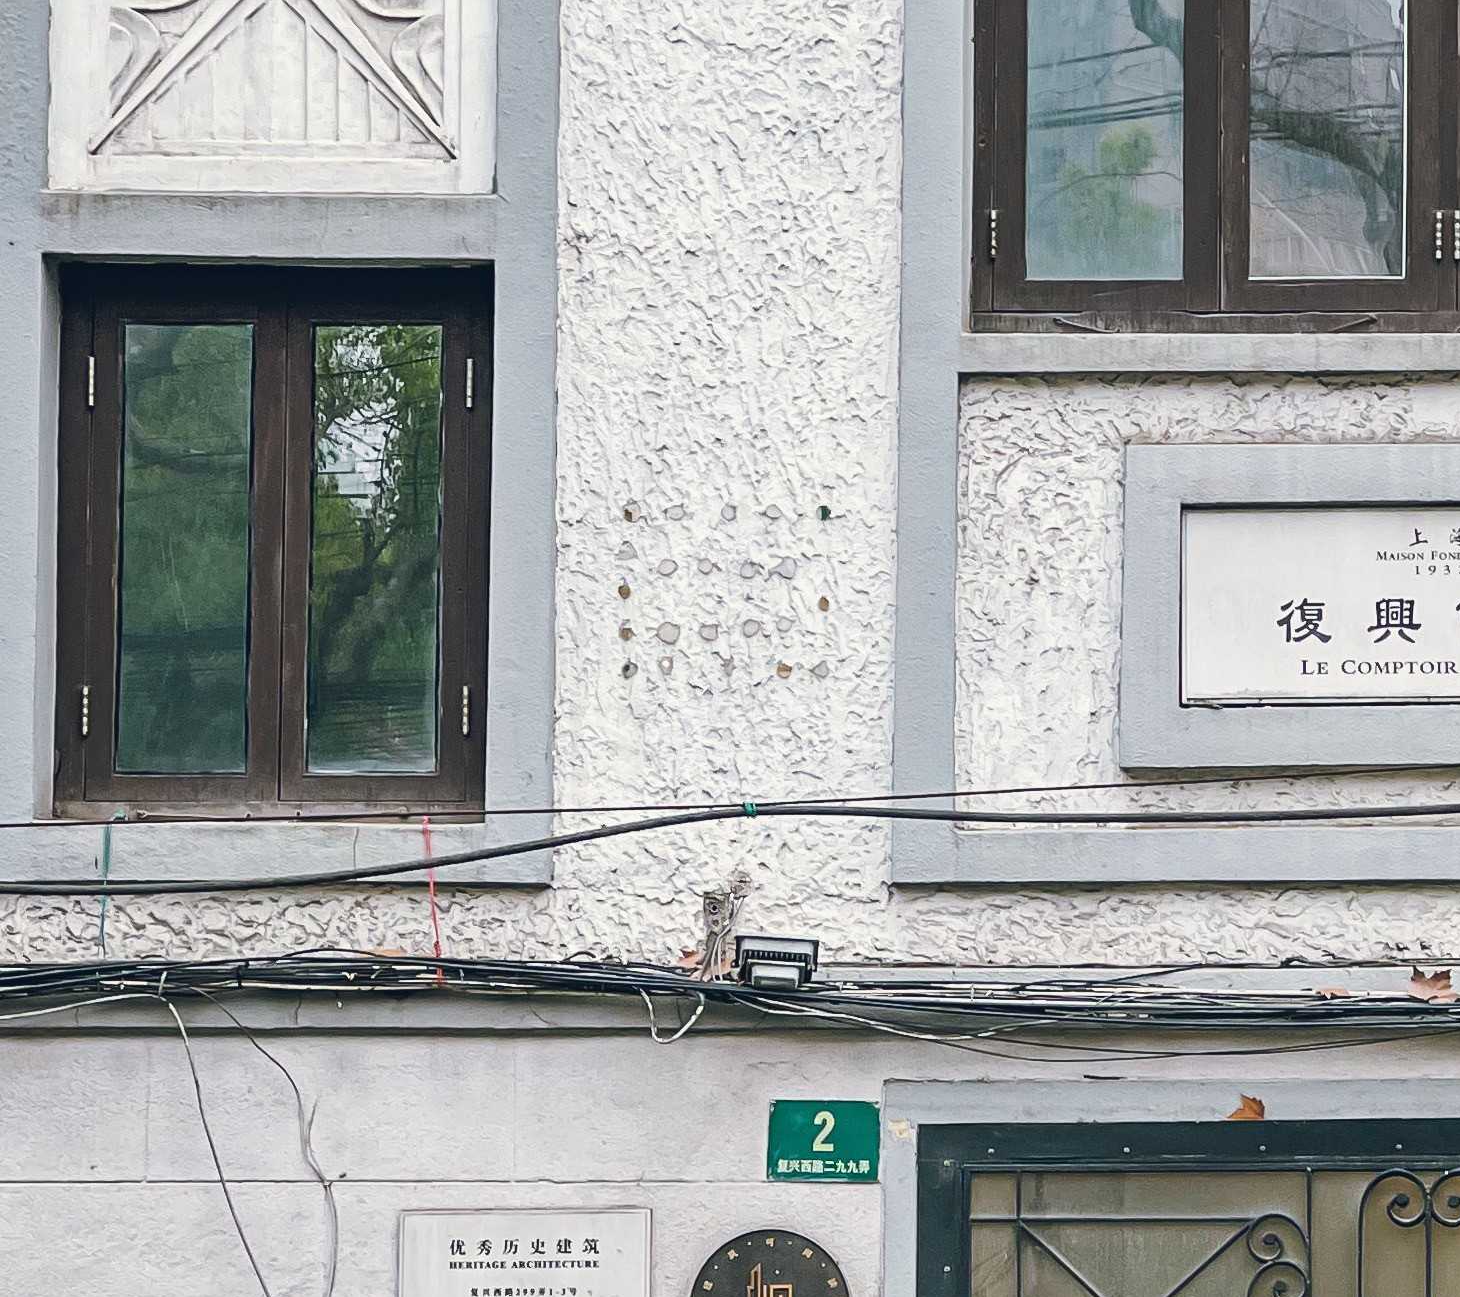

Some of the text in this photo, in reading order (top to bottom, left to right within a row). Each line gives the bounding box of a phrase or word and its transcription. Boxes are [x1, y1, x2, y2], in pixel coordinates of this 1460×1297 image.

[1341, 658, 1458, 675] COMPTOIR
[812, 1110, 835, 1152] 2
[777, 1158, 870, 1174] 复兴西路二九九弄
[449, 1238, 601, 1256] 优秀历史建筑
[449, 1259, 600, 1269] HERITAGE ARCHITECTURE
